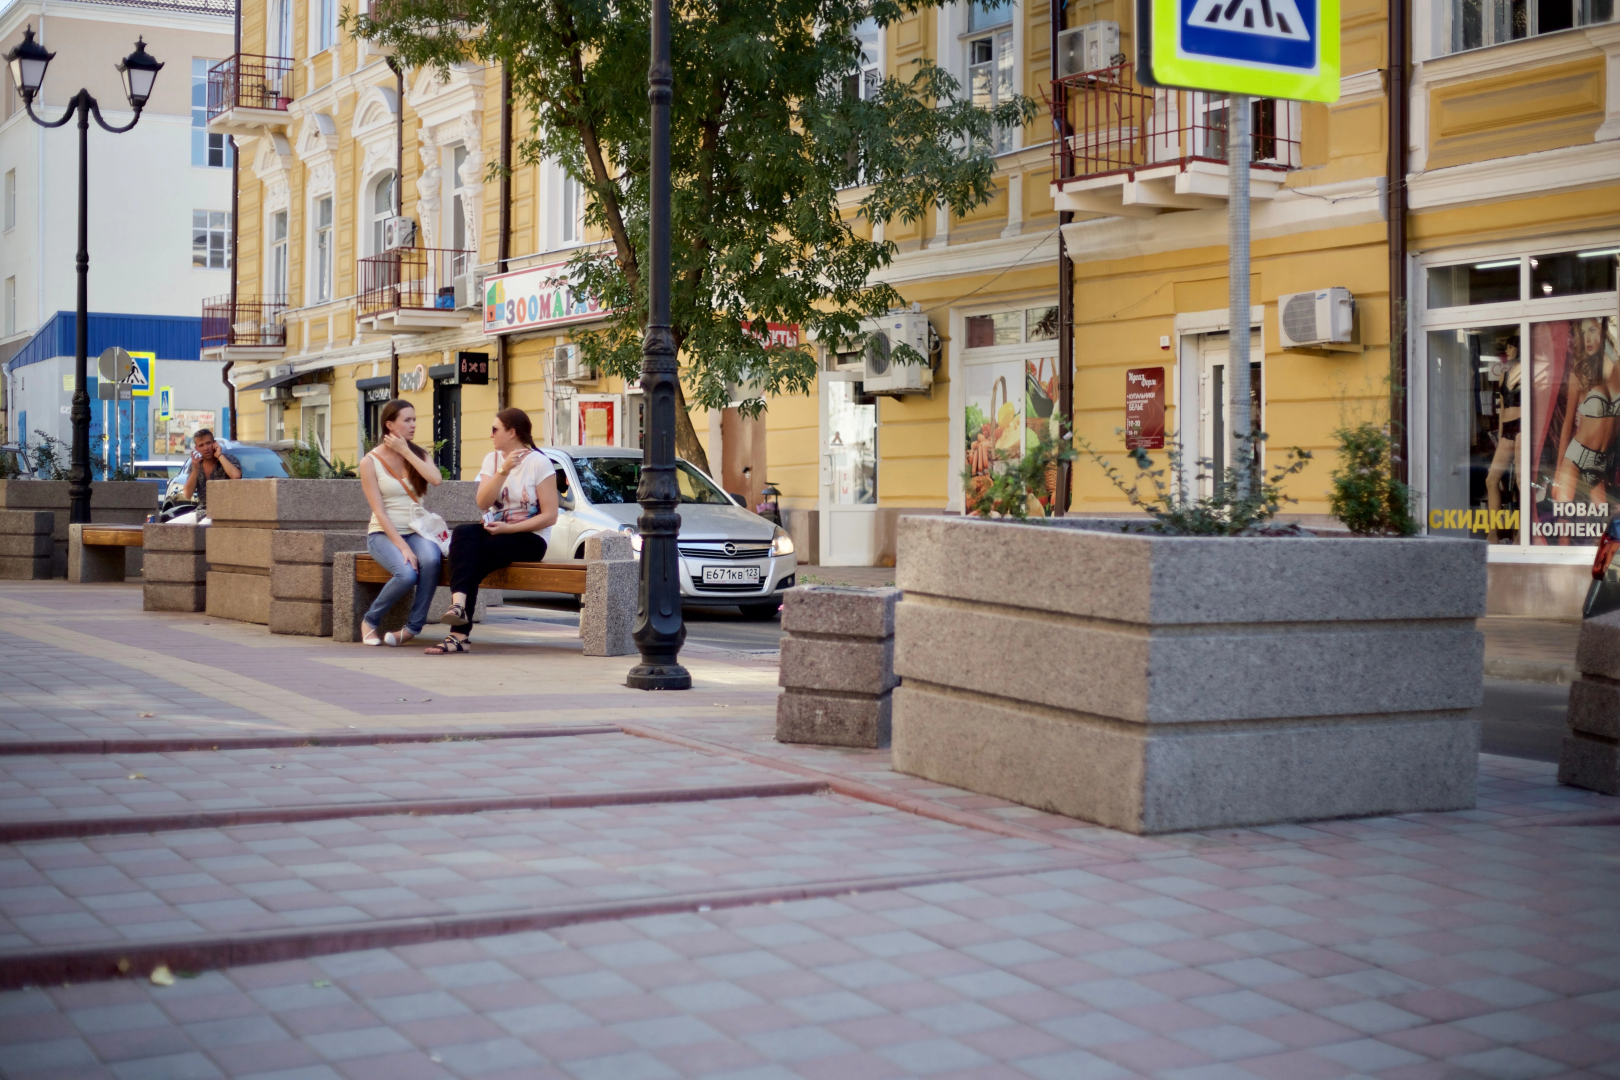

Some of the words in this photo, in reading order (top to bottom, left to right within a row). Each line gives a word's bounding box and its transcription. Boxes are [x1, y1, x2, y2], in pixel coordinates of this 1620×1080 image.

[506, 281, 628, 325] ЗООМАГАЗ
[1128, 392, 1156, 400] КУПАЛЬНИКИ
[1553, 502, 1609, 517] НОВАЯ
[1429, 508, 1520, 534] СКИДКИ
[745, 568, 758, 577] 123
